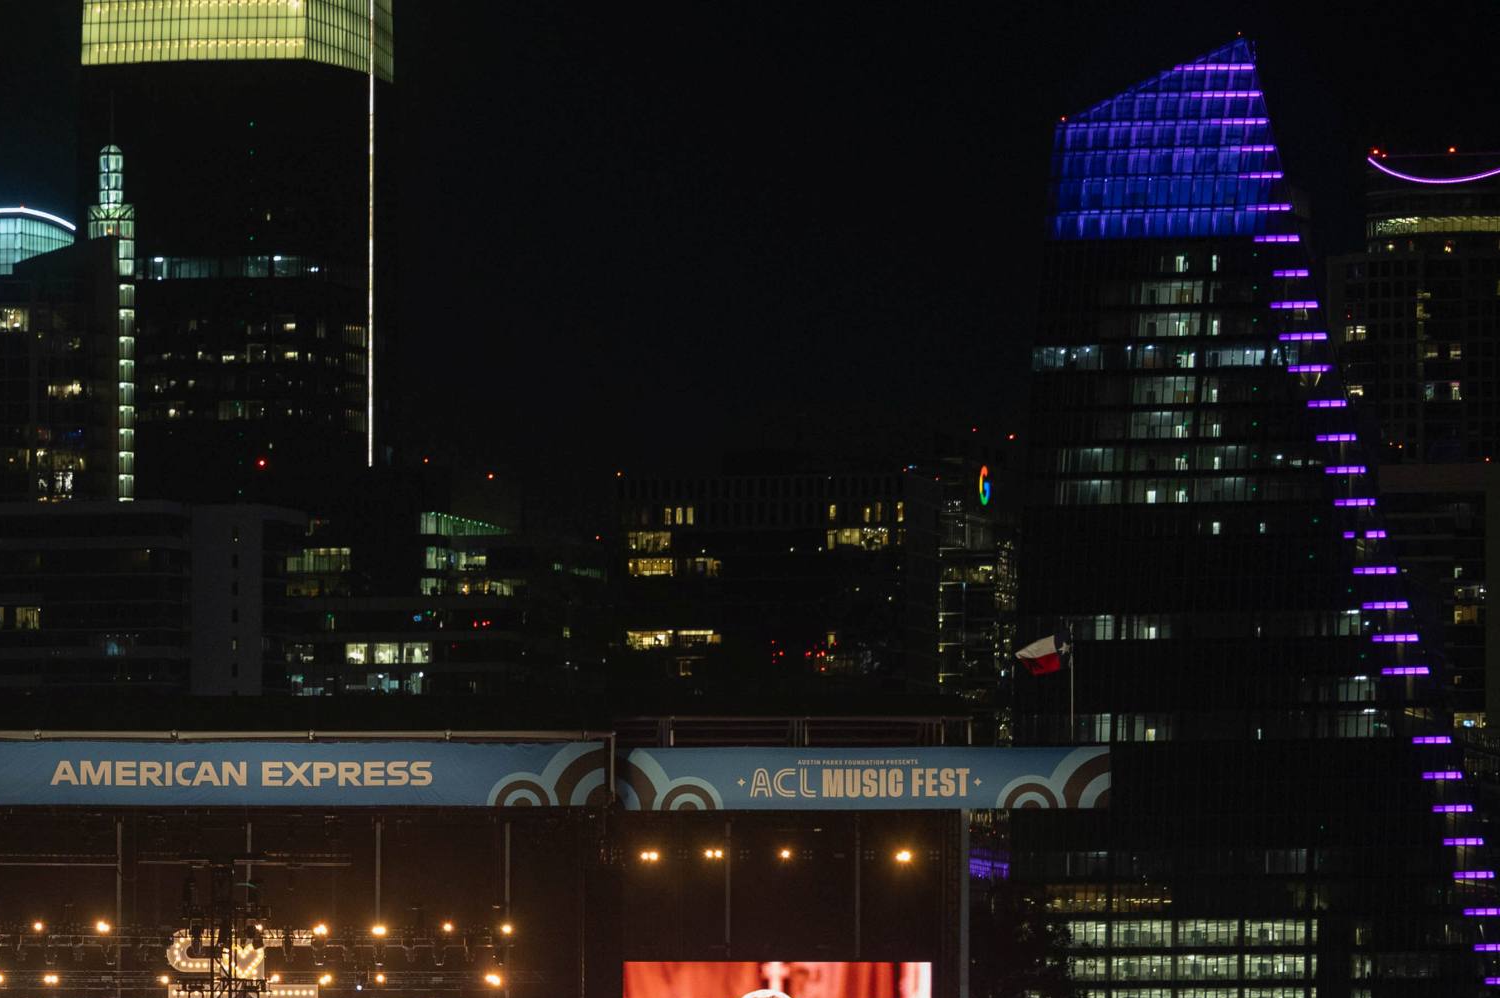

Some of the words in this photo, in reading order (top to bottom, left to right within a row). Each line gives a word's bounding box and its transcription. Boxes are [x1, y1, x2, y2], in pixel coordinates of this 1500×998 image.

[50, 760, 247, 787] AMERICAN
[261, 760, 433, 787] EXPRESS
[886, 758, 918, 766] PRESENTS
[750, 768, 816, 798] ACL
[822, 768, 904, 798] MUSIC
[911, 767, 970, 797] FEST
